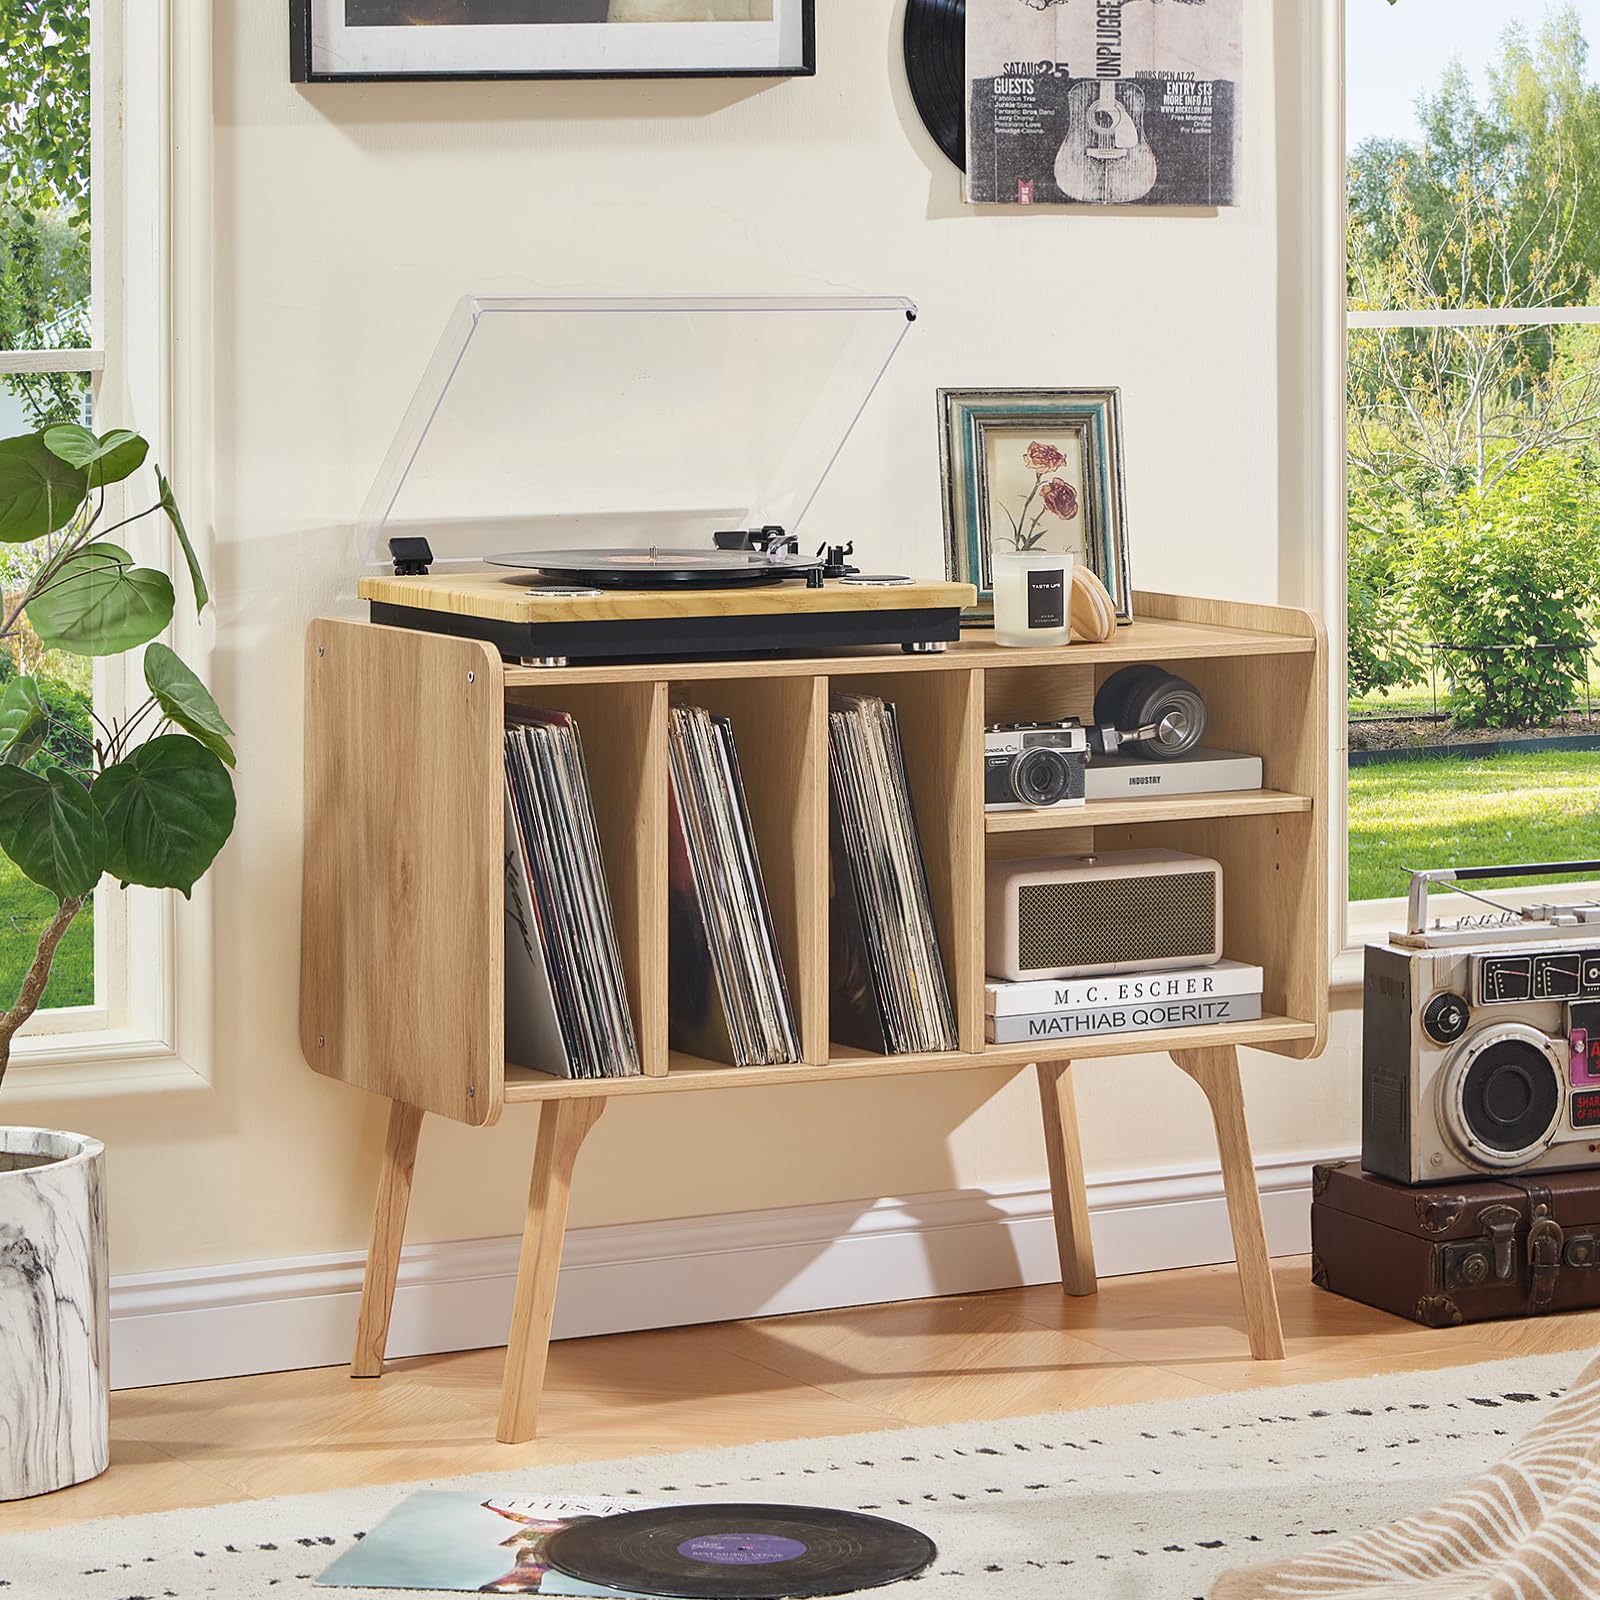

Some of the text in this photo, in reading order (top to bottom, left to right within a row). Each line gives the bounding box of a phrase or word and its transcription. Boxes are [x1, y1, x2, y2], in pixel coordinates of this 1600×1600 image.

[1038, 60, 1069, 79] 25
[1135, 71, 1195, 82] DOORS OPEN AT 22
[994, 78, 1034, 95] GUESTS
[1166, 81, 1213, 96] ENTRY $13
[1163, 95, 1213, 106] MORE INFO AT
[1129, 775, 1161, 786] INDUSTRY
[1118, 977, 1214, 1000] ESCHER
[1028, 1001, 1231, 1036] MATHIAB QOERITZ
